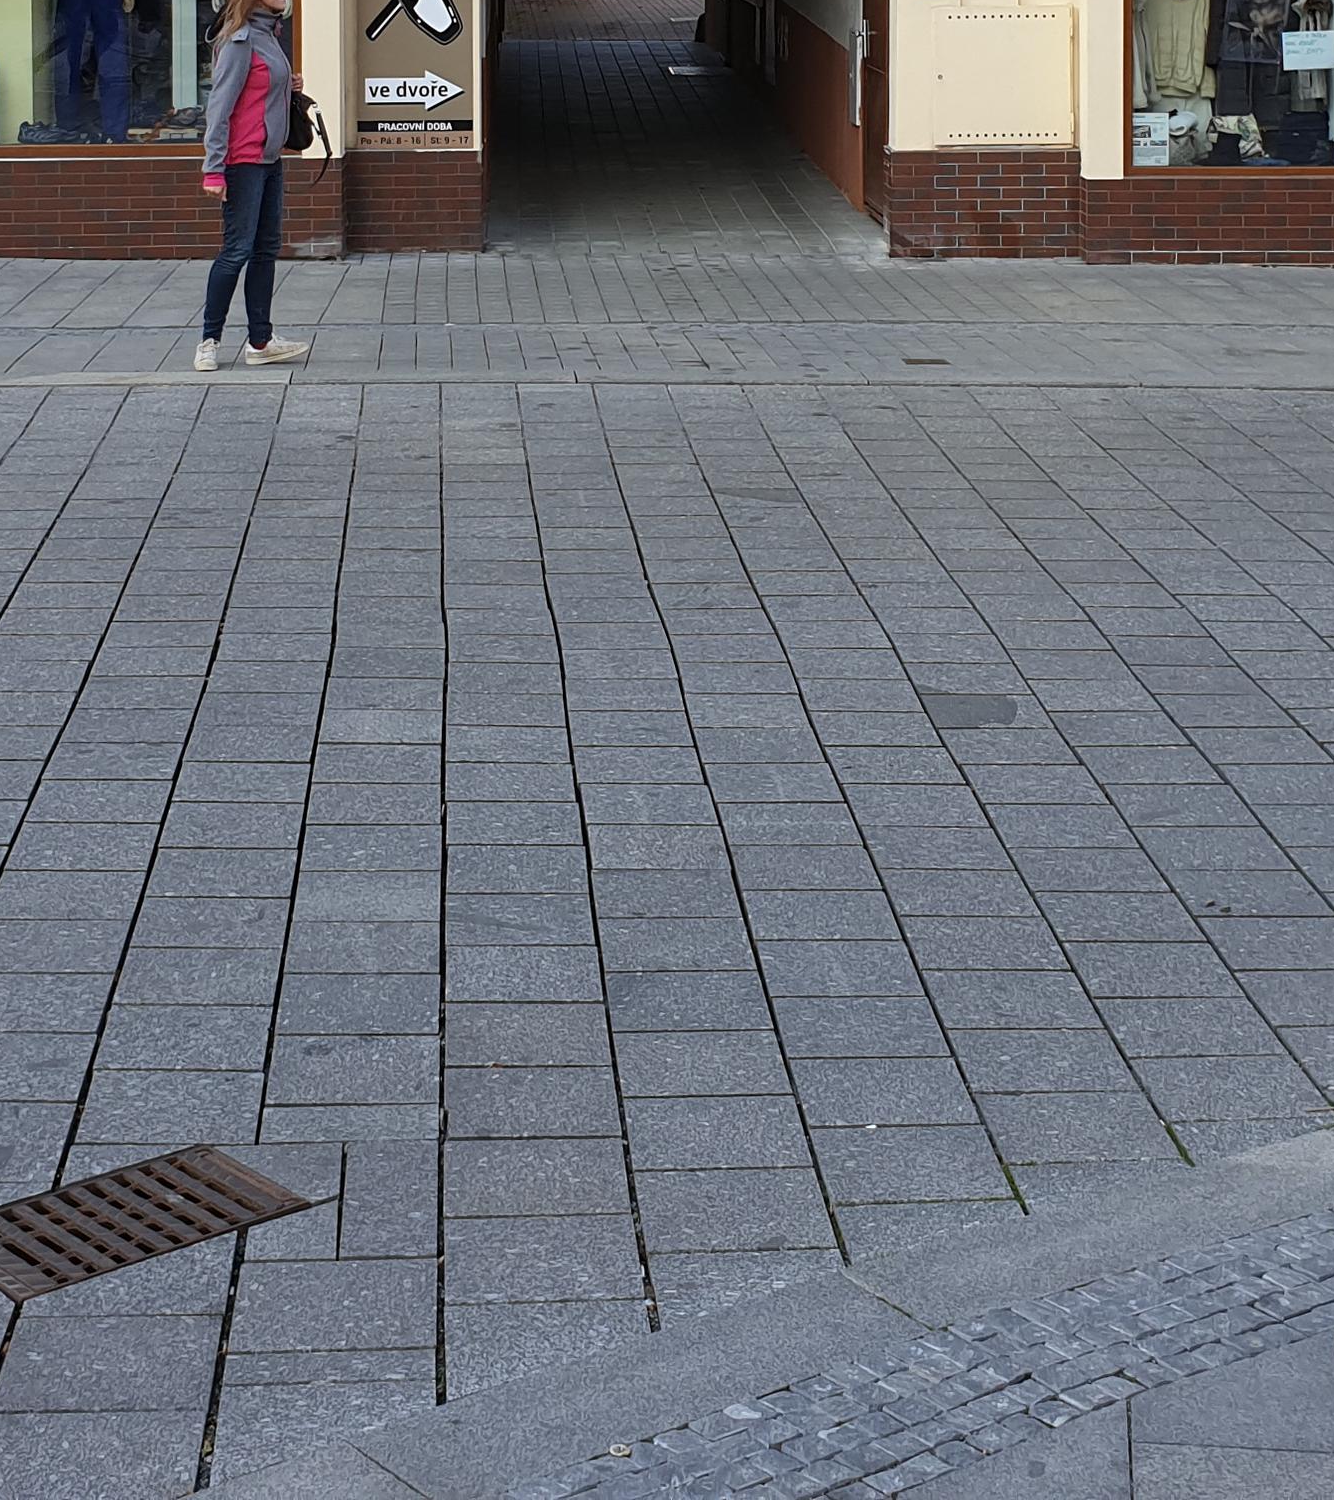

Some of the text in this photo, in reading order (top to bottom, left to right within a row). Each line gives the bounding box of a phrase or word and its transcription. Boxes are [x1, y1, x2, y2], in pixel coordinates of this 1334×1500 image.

[368, 80, 448, 98] ve dvoře
[378, 121, 452, 131] PRACOVNÍ DOBA
